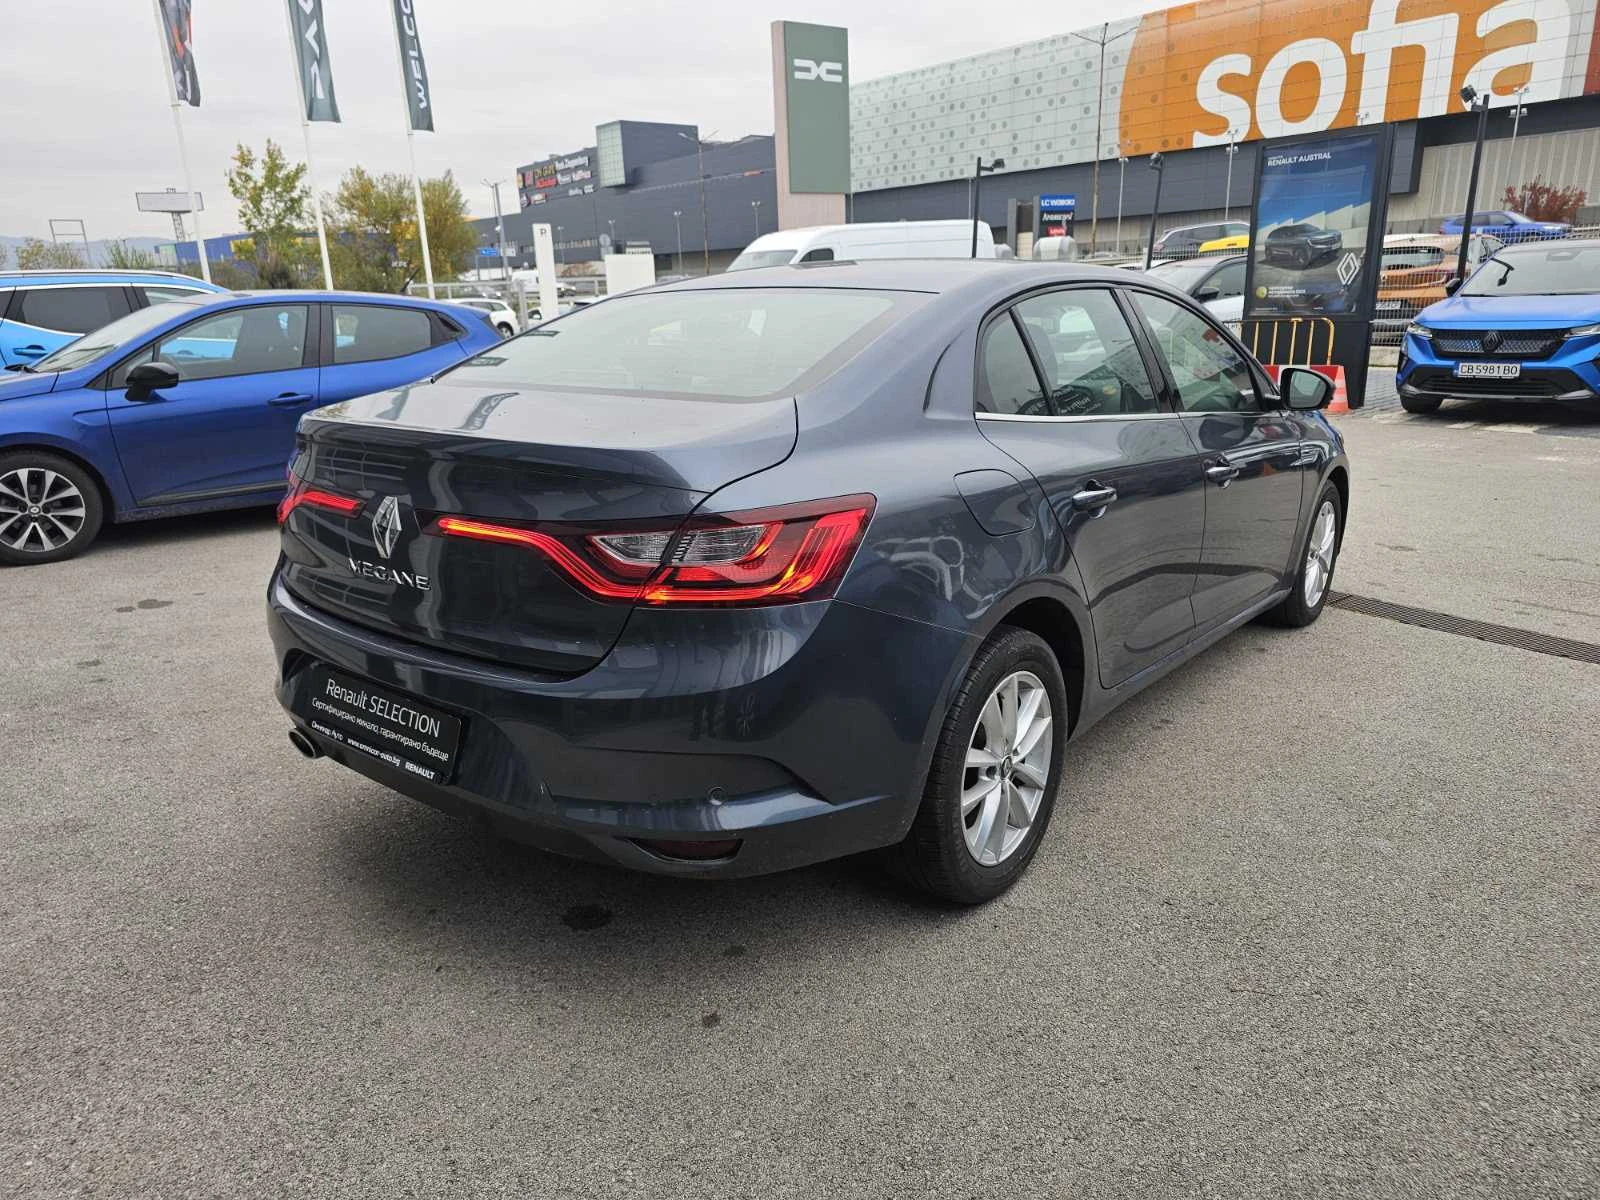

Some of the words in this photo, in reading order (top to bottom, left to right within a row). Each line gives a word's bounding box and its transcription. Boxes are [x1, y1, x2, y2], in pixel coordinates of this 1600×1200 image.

[1192, 0, 1570, 149] sofia
[1268, 156, 1298, 167] RENAULT
[1298, 152, 1331, 162] AUSTRAL
[348, 557, 431, 590] MEGANE
[326, 679, 367, 710] Renault
[368, 695, 441, 738] SELECTION
[405, 761, 435, 780] RENAULT
